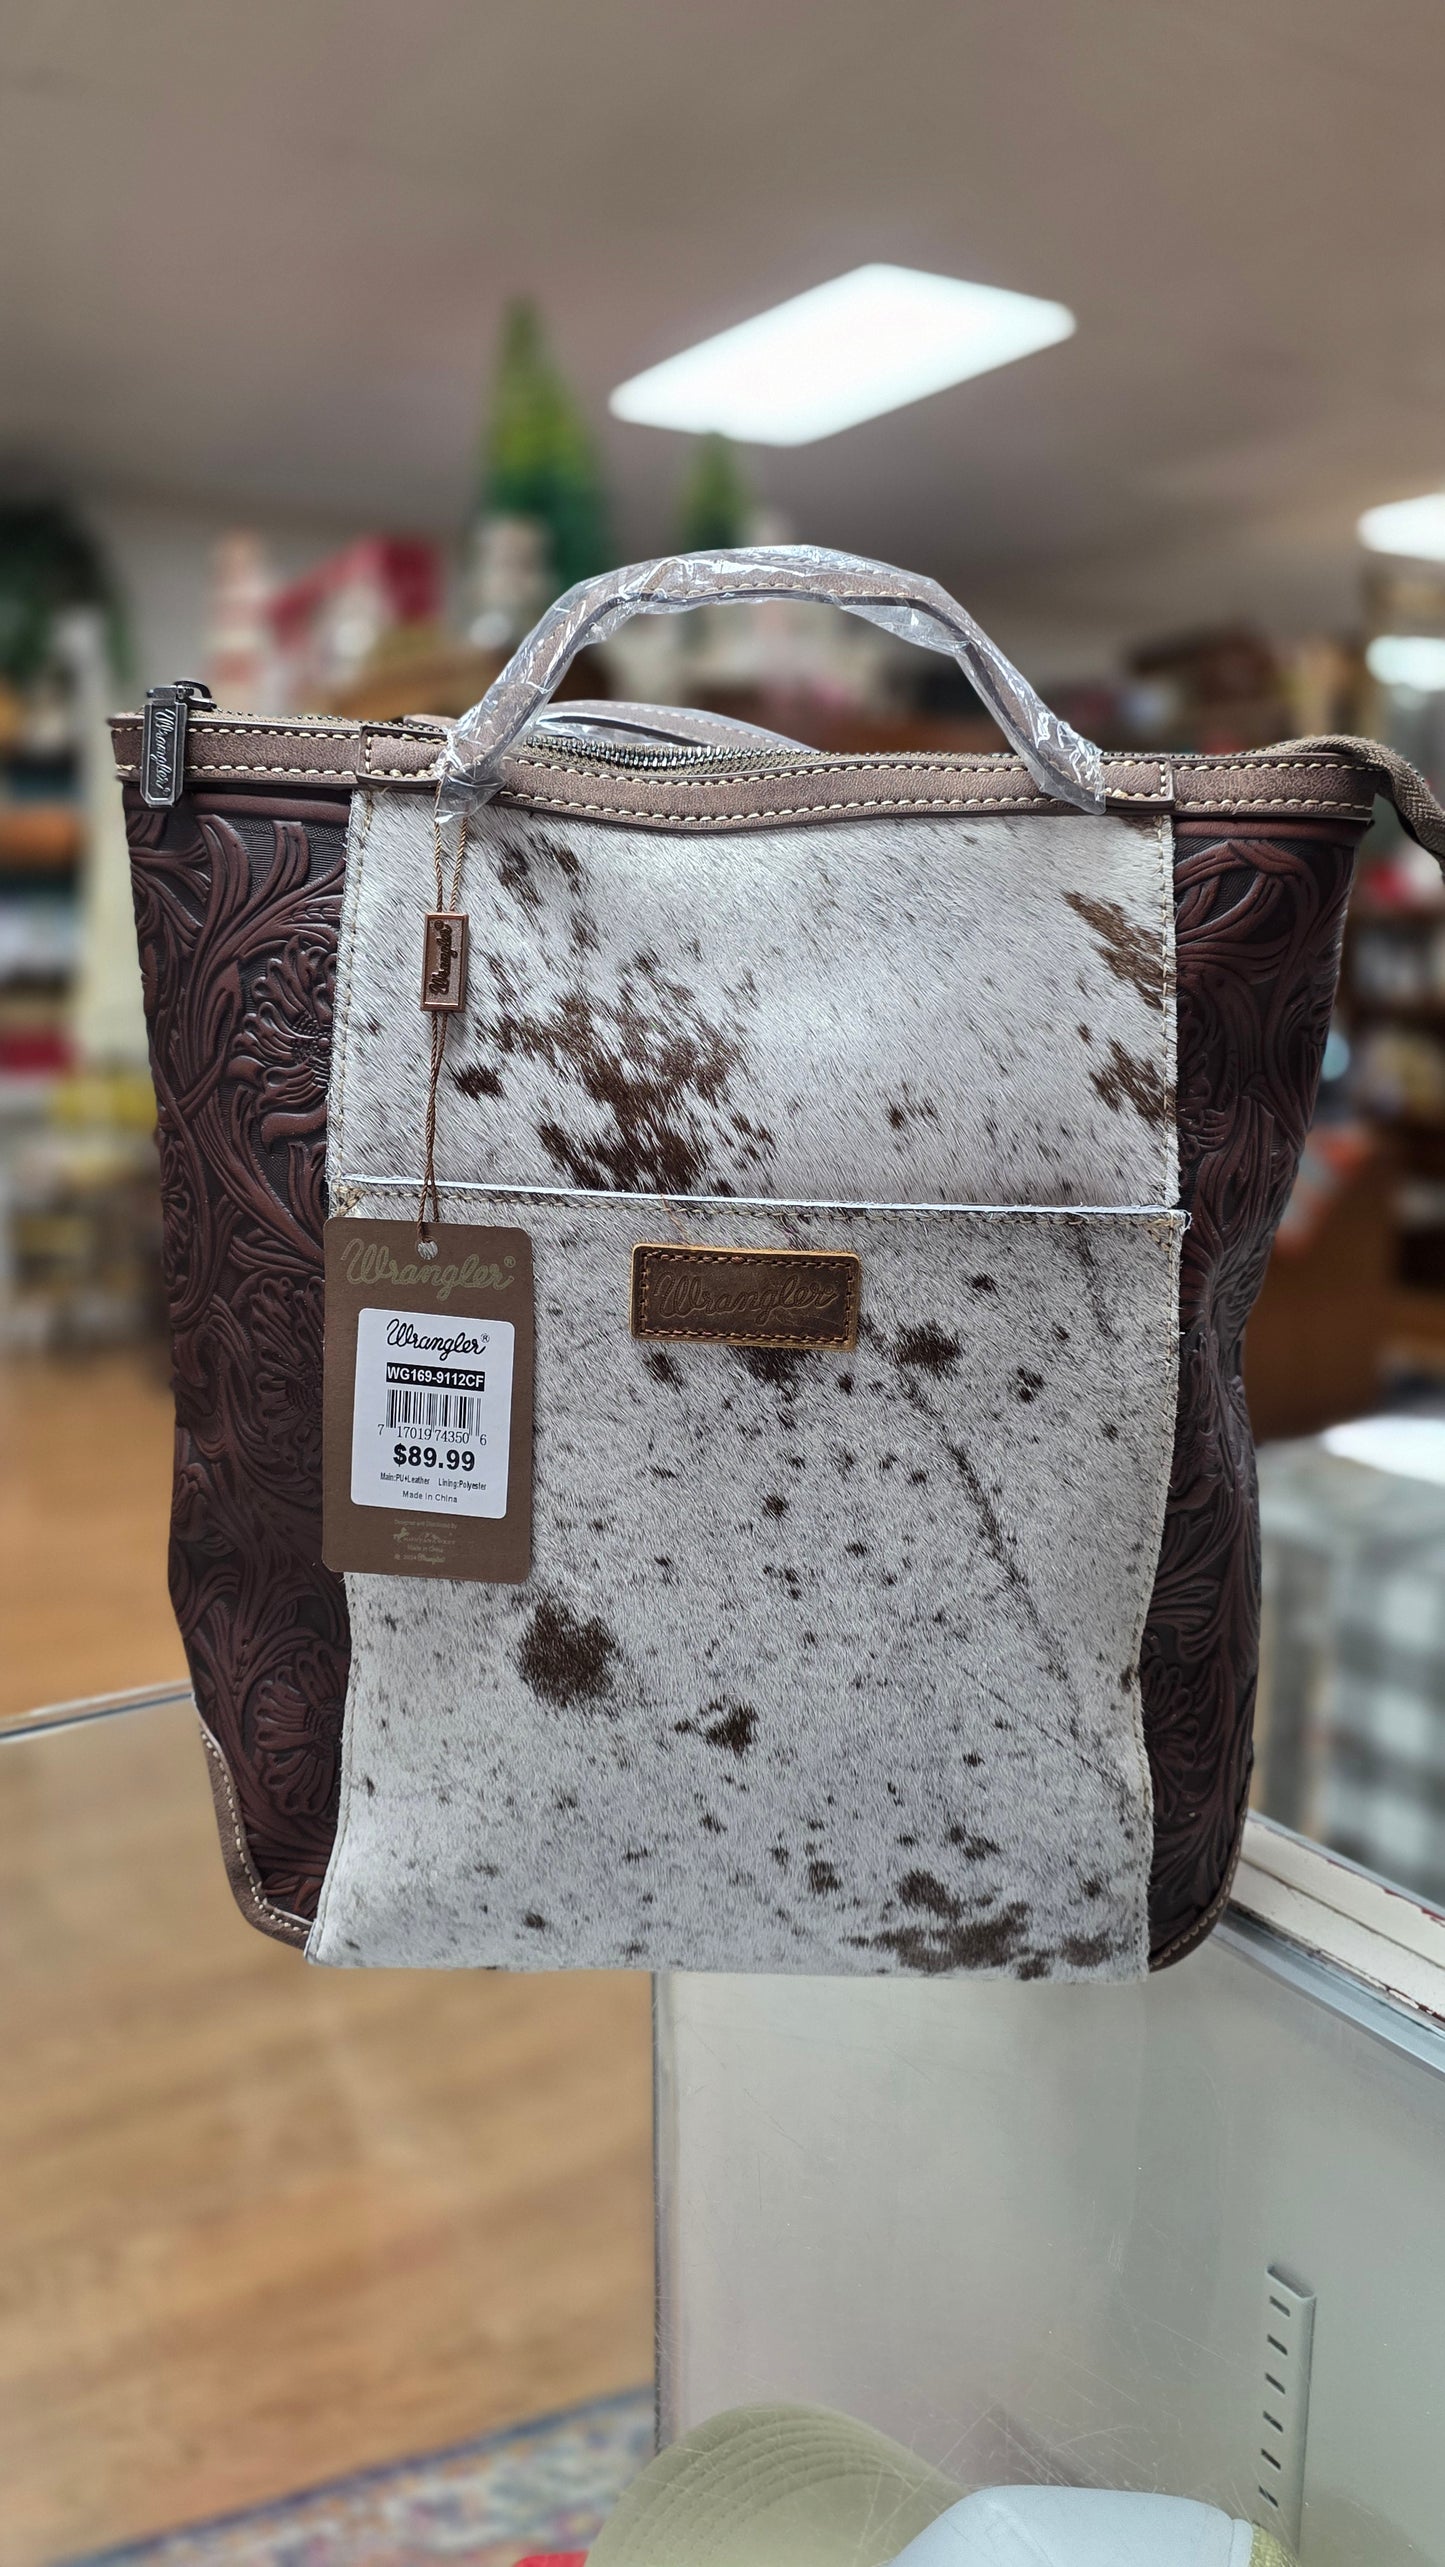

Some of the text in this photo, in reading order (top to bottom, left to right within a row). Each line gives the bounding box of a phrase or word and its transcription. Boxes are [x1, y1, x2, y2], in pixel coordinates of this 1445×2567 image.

[387, 1365, 484, 1388] WG169-9112CF
[377, 1423, 487, 1446] 7 17019 74350 6
[393, 1442, 475, 1472] $89.99
[438, 1477, 487, 1491] Lining:Polyester
[402, 1490, 423, 1500] Made
[435, 1493, 458, 1503] China
